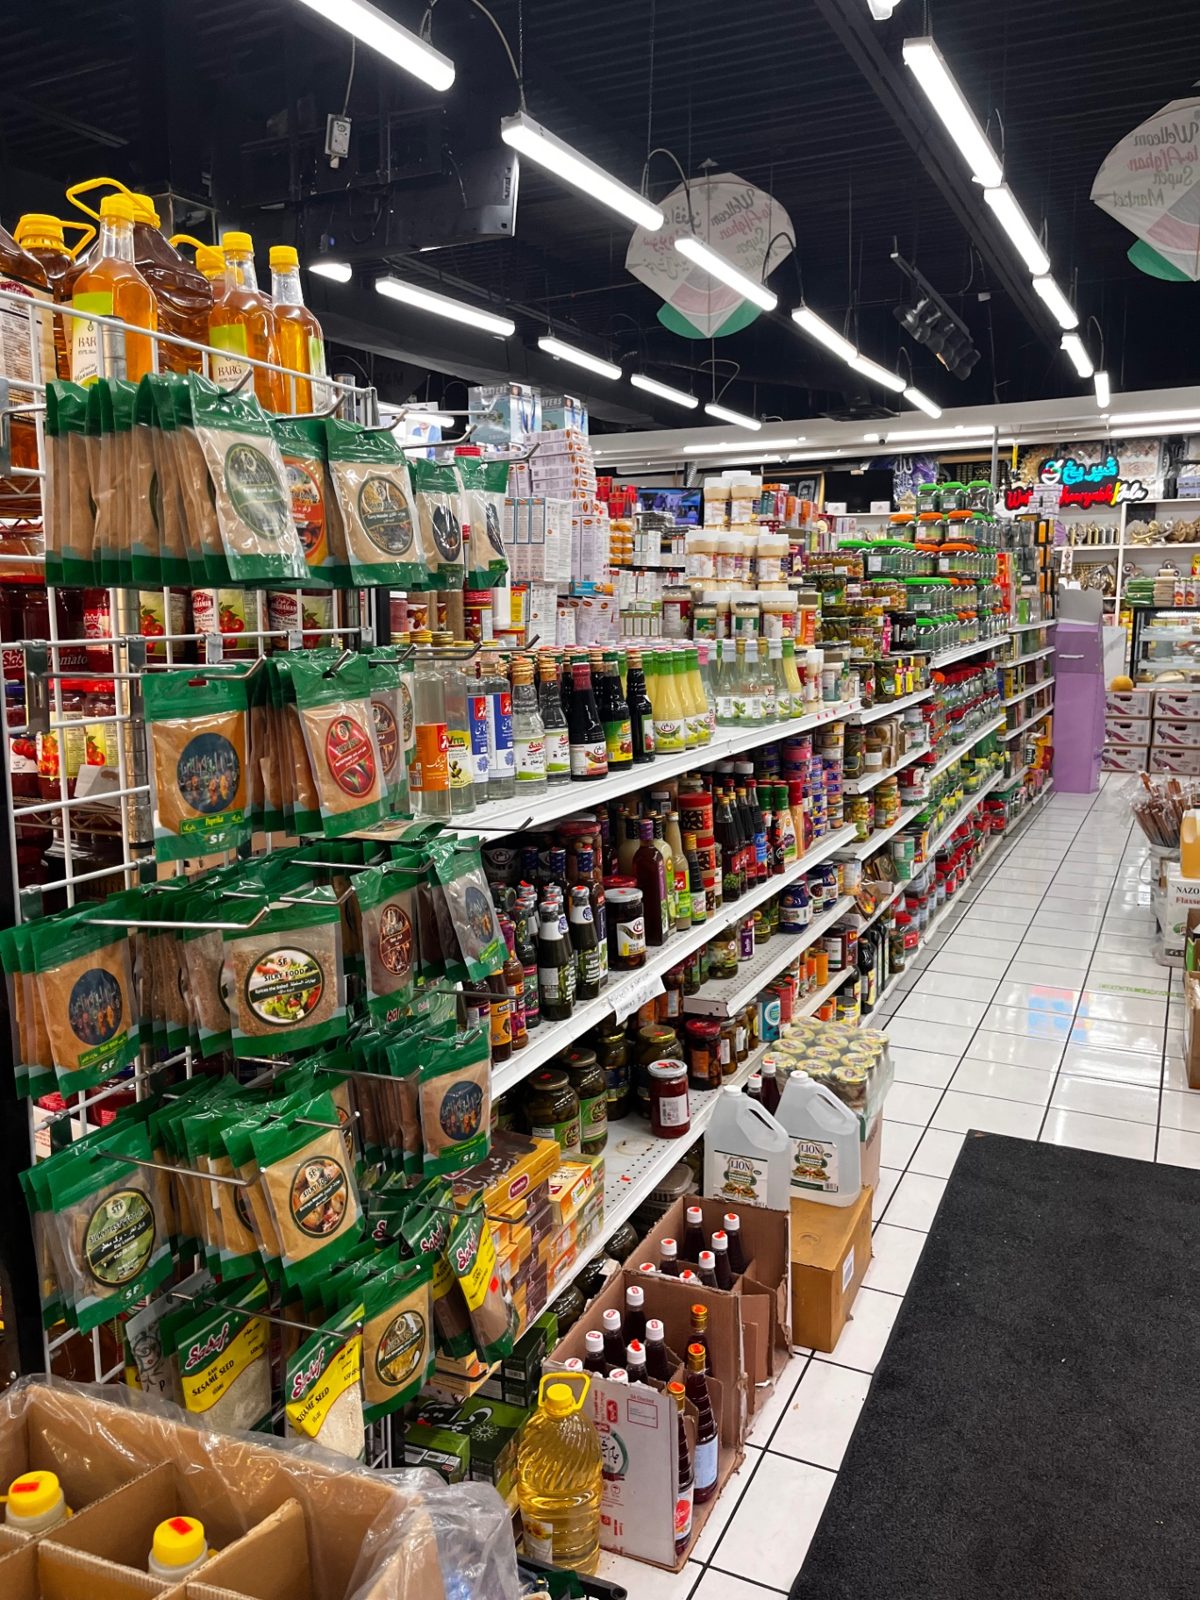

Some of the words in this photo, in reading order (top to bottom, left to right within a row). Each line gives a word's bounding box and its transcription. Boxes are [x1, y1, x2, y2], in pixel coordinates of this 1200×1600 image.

[78, 337, 97, 348] BAR
[218, 364, 242, 376] BARG
[209, 832, 225, 844] SF
[264, 972, 283, 982] SILKY
[285, 968, 305, 977] FOOD
[101, 1059, 115, 1073] SF
[801, 1143, 821, 1155] LION
[463, 1152, 475, 1162] SF
[730, 1160, 752, 1172] LION
[111, 1201, 123, 1214] STF
[125, 1284, 140, 1300] SF
[185, 1321, 229, 1370] Sadaf
[192, 1373, 218, 1396] SESAME
[219, 1360, 235, 1376] SEED
[291, 1346, 325, 1399] Sadaf
[315, 1386, 330, 1404] SEED
